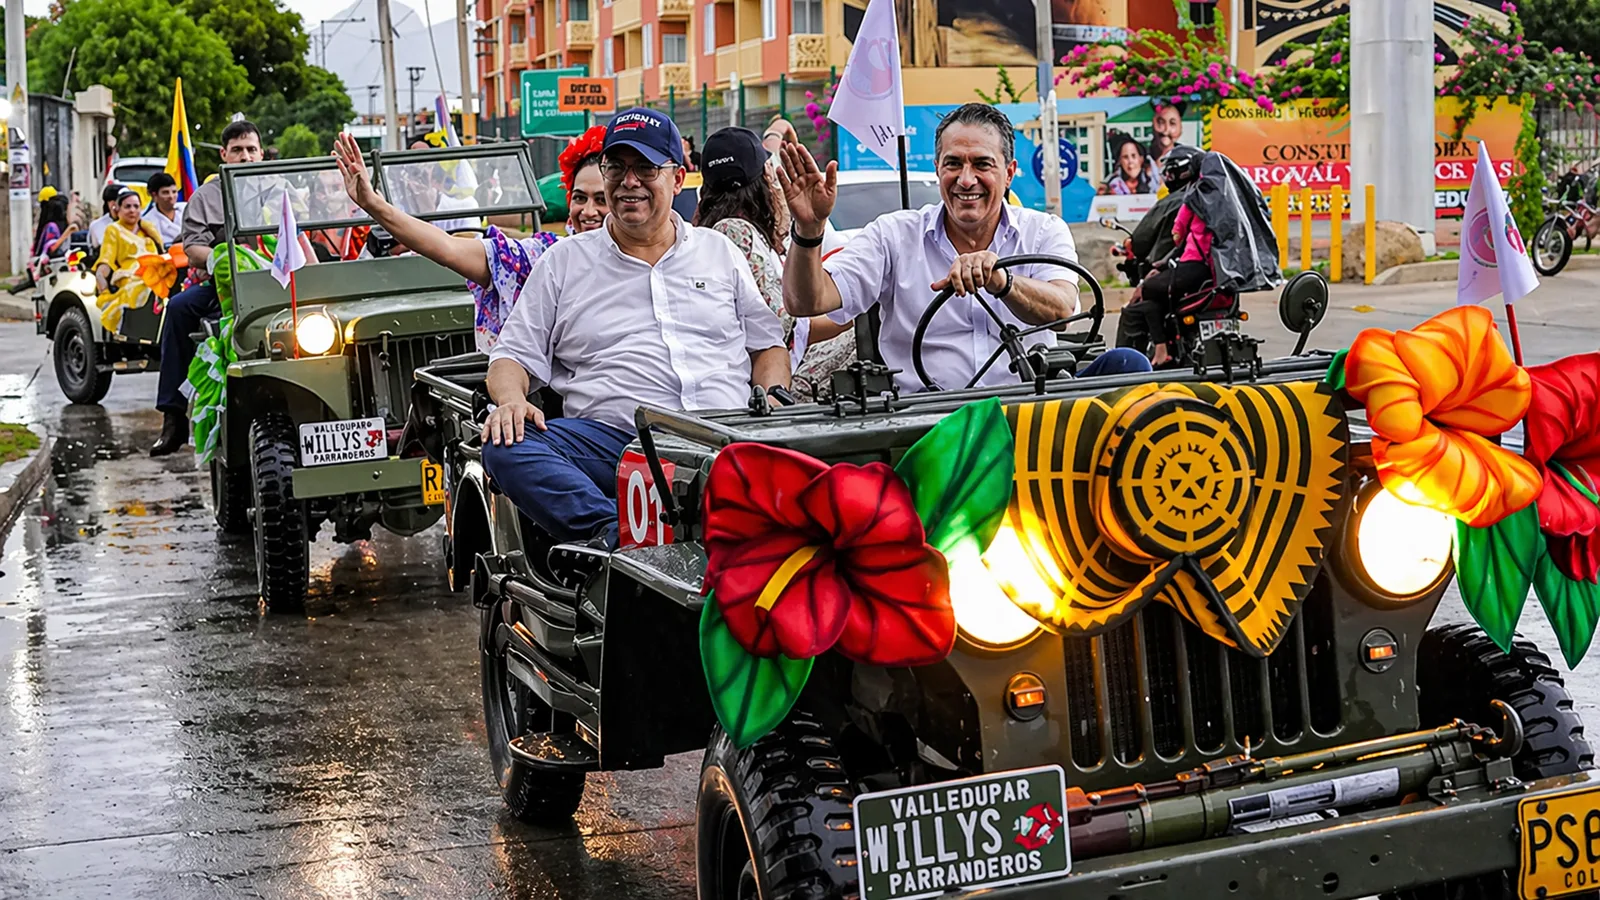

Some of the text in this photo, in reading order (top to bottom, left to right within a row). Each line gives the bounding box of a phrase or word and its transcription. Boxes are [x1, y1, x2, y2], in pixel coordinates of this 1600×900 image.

[303, 431, 361, 454] WILLYS
[627, 470, 665, 546] 01
[890, 779, 1031, 819] VALLEDUPAR
[866, 808, 1003, 874] WILLYS
[889, 850, 1042, 895] PARRANDEROS
